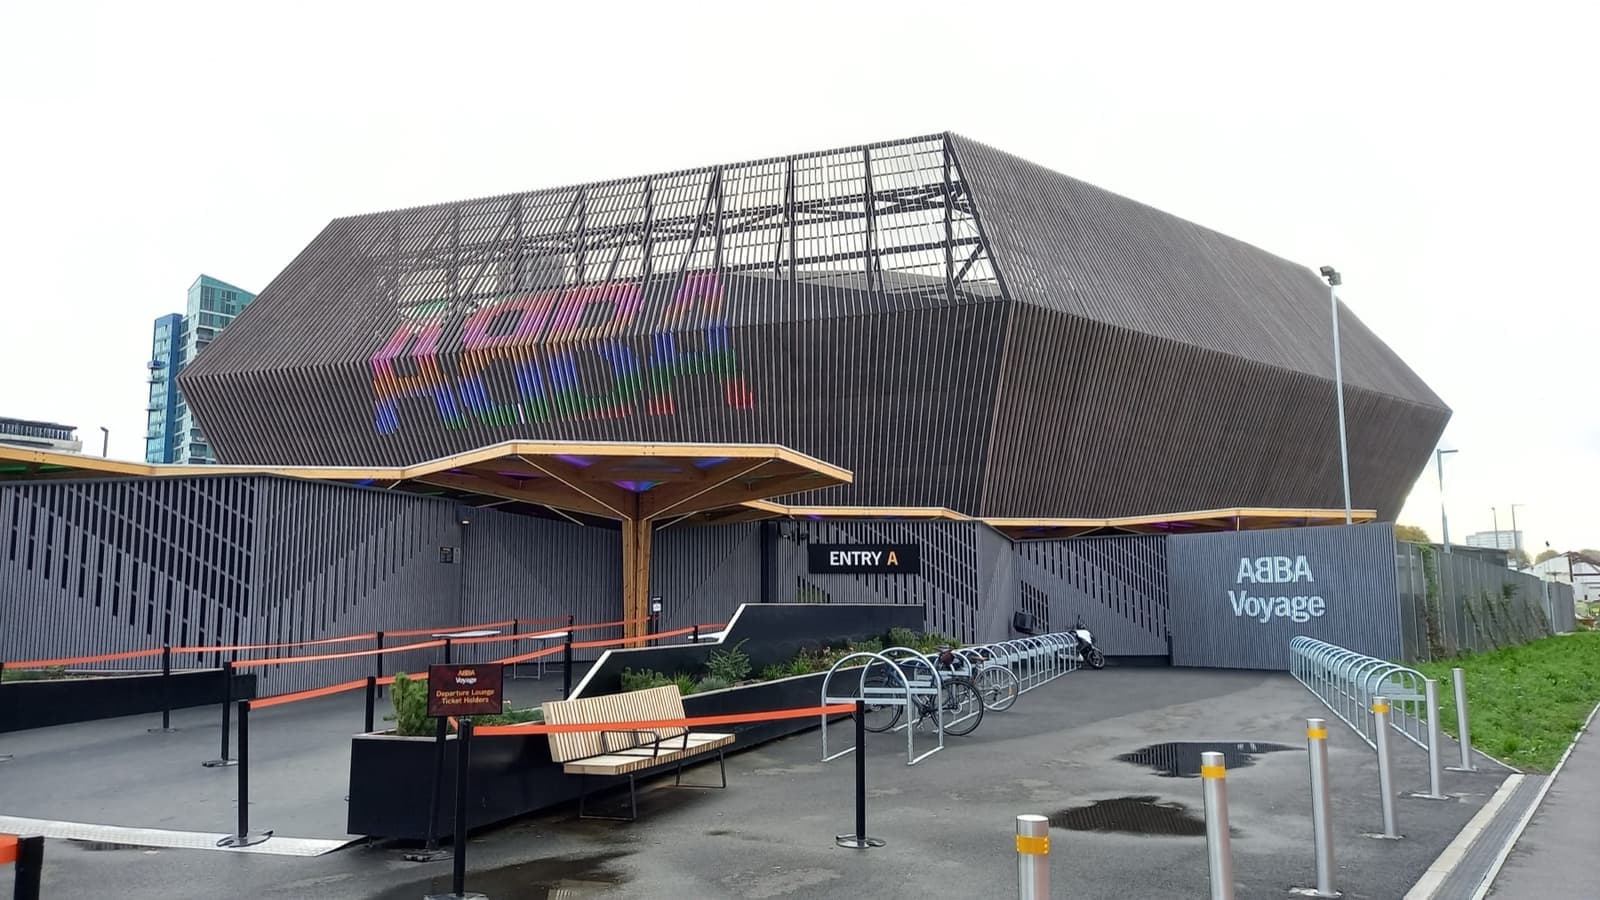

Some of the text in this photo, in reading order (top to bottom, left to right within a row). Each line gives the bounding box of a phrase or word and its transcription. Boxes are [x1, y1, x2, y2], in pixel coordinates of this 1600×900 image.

[829, 551, 899, 566] ENTRY A
[1236, 555, 1315, 584] ABBA
[1227, 590, 1326, 624] Voyage
